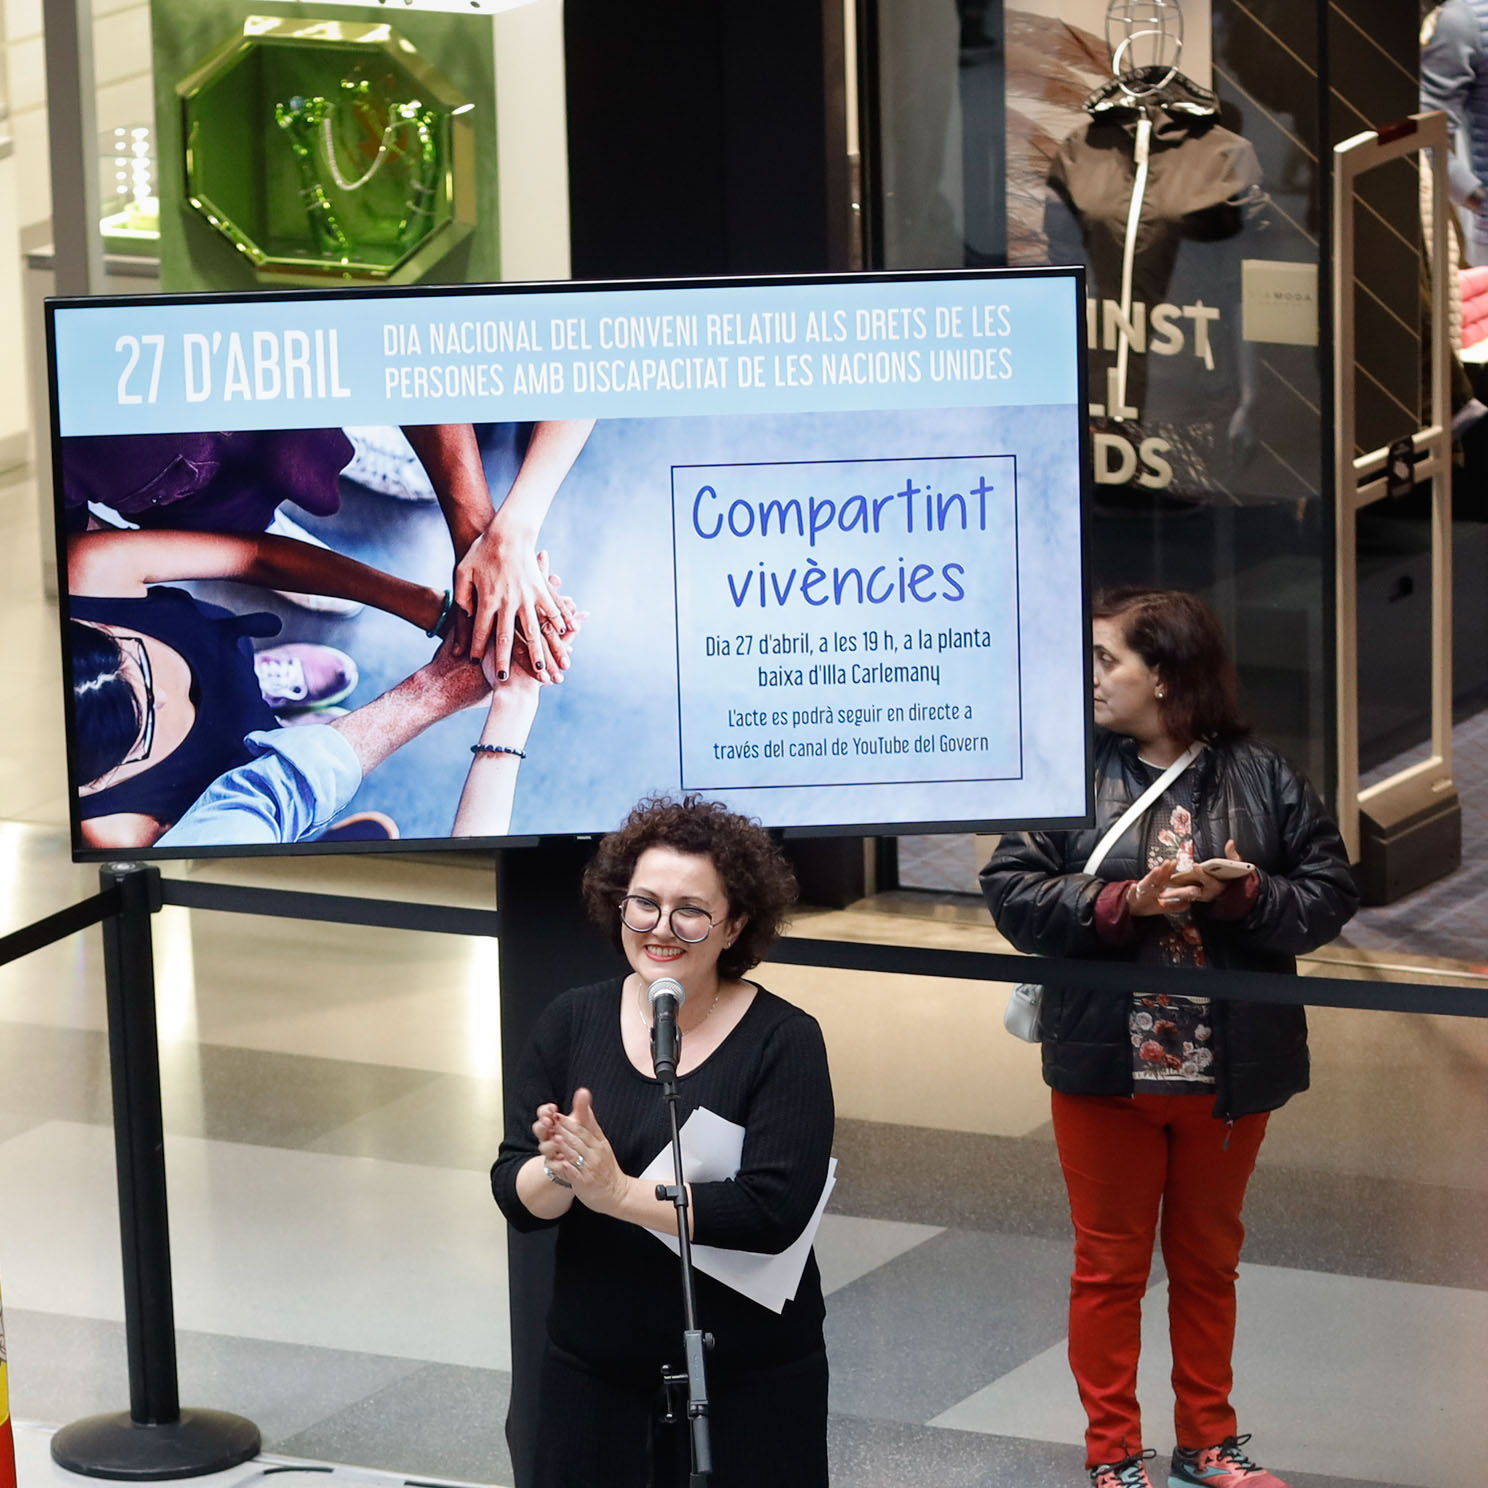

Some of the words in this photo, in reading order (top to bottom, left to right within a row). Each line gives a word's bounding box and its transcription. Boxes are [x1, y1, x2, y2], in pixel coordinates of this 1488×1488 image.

[383, 323, 423, 357] DIA
[429, 319, 543, 355] NACIONAL
[550, 318, 593, 351] DEL
[599, 315, 698, 350] CONVENI
[706, 311, 797, 346] RELATIU
[805, 309, 848, 343] ALS
[855, 307, 927, 341] DRETS
[935, 305, 964, 339] DE
[971, 304, 1012, 337] LES
[115, 334, 165, 405] 27
[183, 328, 352, 403] D'ABRIL
[385, 363, 505, 399] PERSONES
[513, 361, 565, 395] AMB
[572, 356, 729, 393] DISCAPACITAT
[737, 355, 766, 388] DE
[774, 353, 814, 387] LES
[821, 350, 922, 385] NACIONS
[929, 347, 1013, 383] UNIDES
[1094, 433, 1174, 489] DS
[692, 475, 995, 548] Compartint
[727, 556, 965, 608] vivències
[706, 635, 731, 657] Dia
[735, 635, 753, 656] 27
[818, 636, 828, 653] a
[834, 631, 858, 653] les
[862, 630, 878, 652] 19
[903, 633, 913, 650] a
[918, 628, 933, 650] la
[938, 627, 991, 654] planta
[758, 665, 803, 687] baixa
[808, 664, 846, 686] d'Illa
[851, 662, 940, 686] Carlemany
[728, 709, 768, 728] L'acte
[771, 711, 788, 726] es
[792, 705, 834, 729] podrà
[837, 704, 883, 727] seguir
[887, 707, 904, 722] en
[908, 703, 960, 722] directe
[964, 705, 973, 720] a
[713, 740, 760, 760] través
[763, 739, 784, 759] del
[789, 738, 827, 758] canal
[831, 737, 849, 756] de
[852, 735, 910, 756] YouTube
[914, 734, 935, 753] del
[939, 734, 989, 753] Govern
